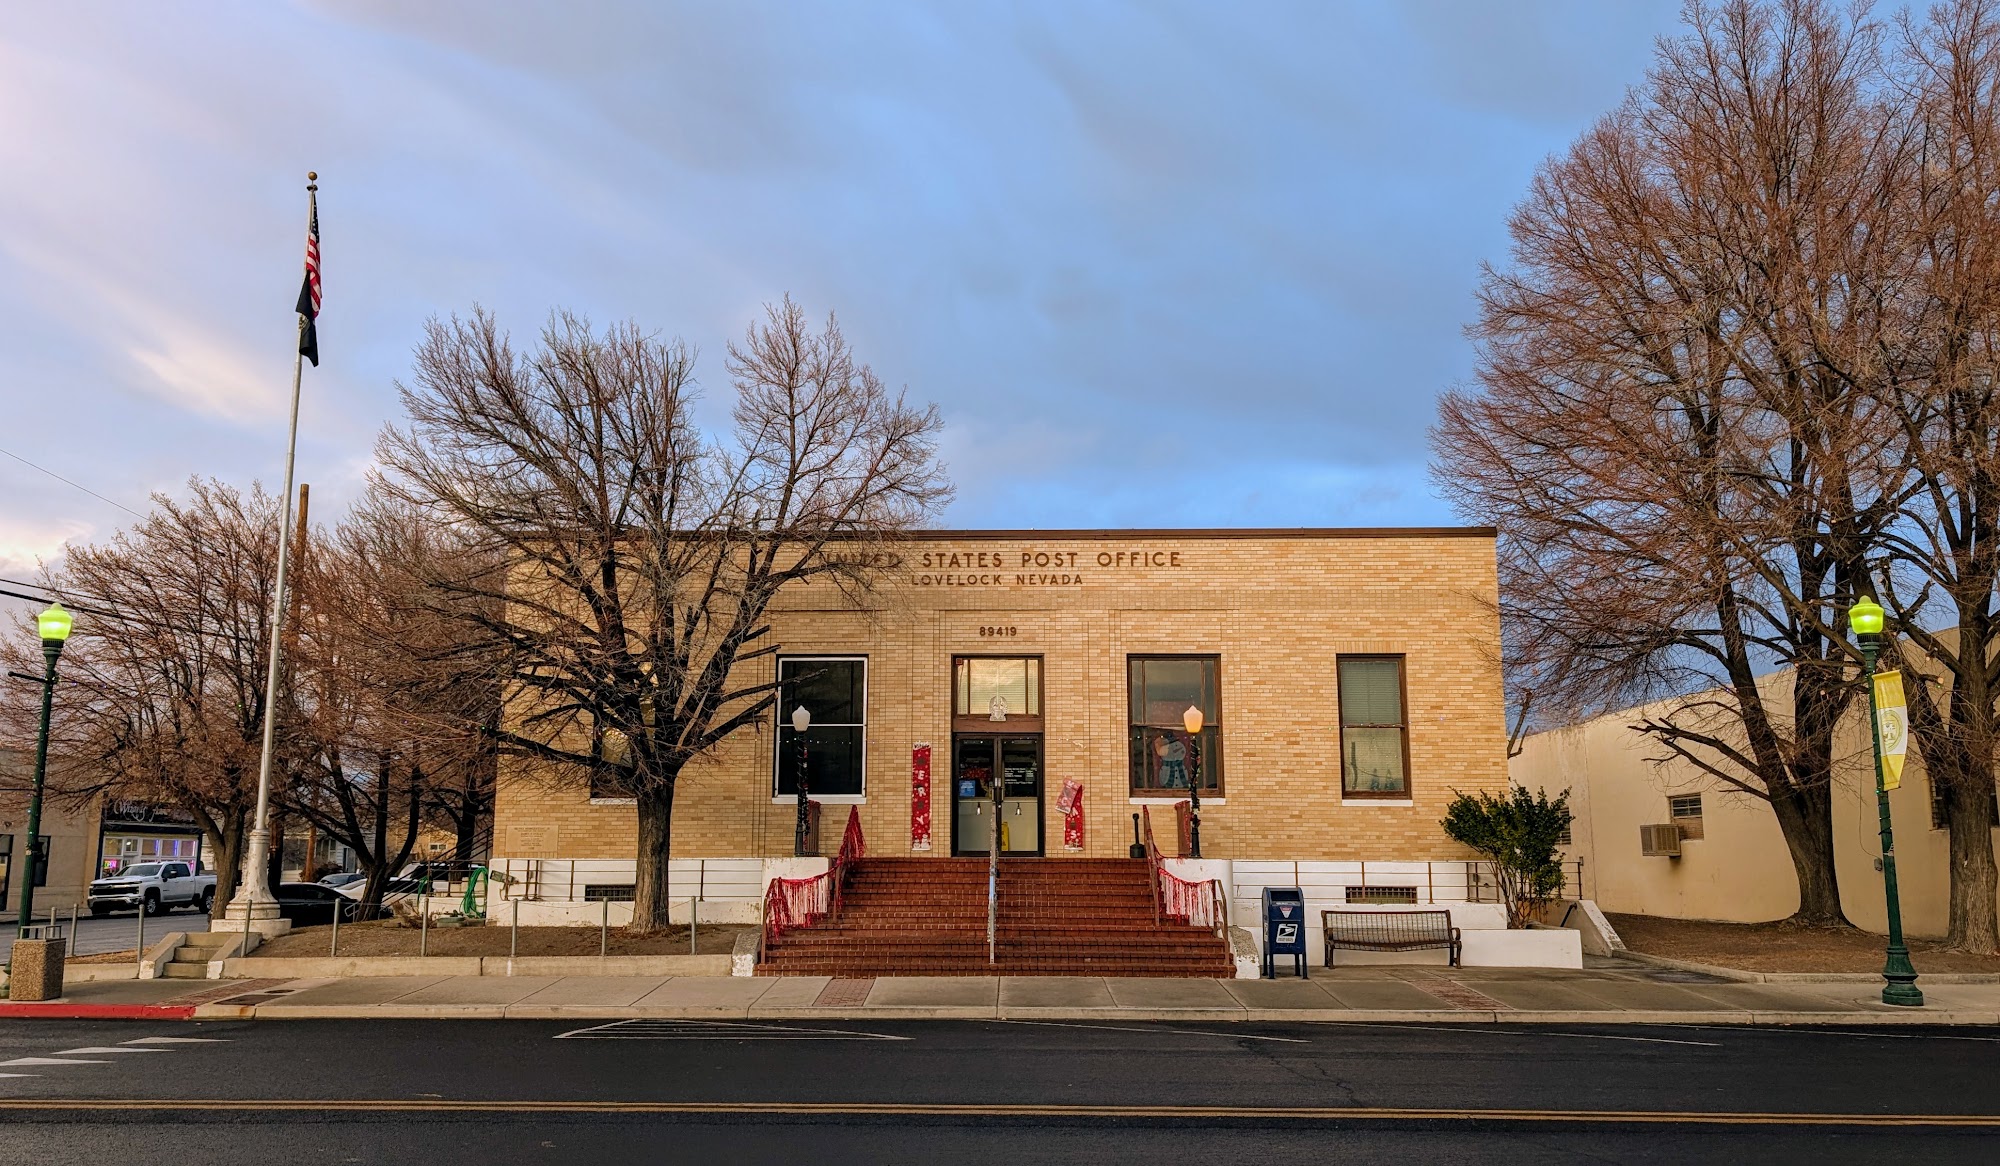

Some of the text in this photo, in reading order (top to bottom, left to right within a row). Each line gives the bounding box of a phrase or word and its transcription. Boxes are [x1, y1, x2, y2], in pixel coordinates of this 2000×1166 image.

[922, 552, 1002, 568] STATES
[1021, 552, 1078, 567] POST
[1097, 551, 1181, 567] OFFICE
[911, 574, 1083, 586] LOVELOCK NEVADA
[979, 626, 1017, 637] 89419
[915, 756, 927, 825] ERY
[104, 860, 117, 870] OPEN
